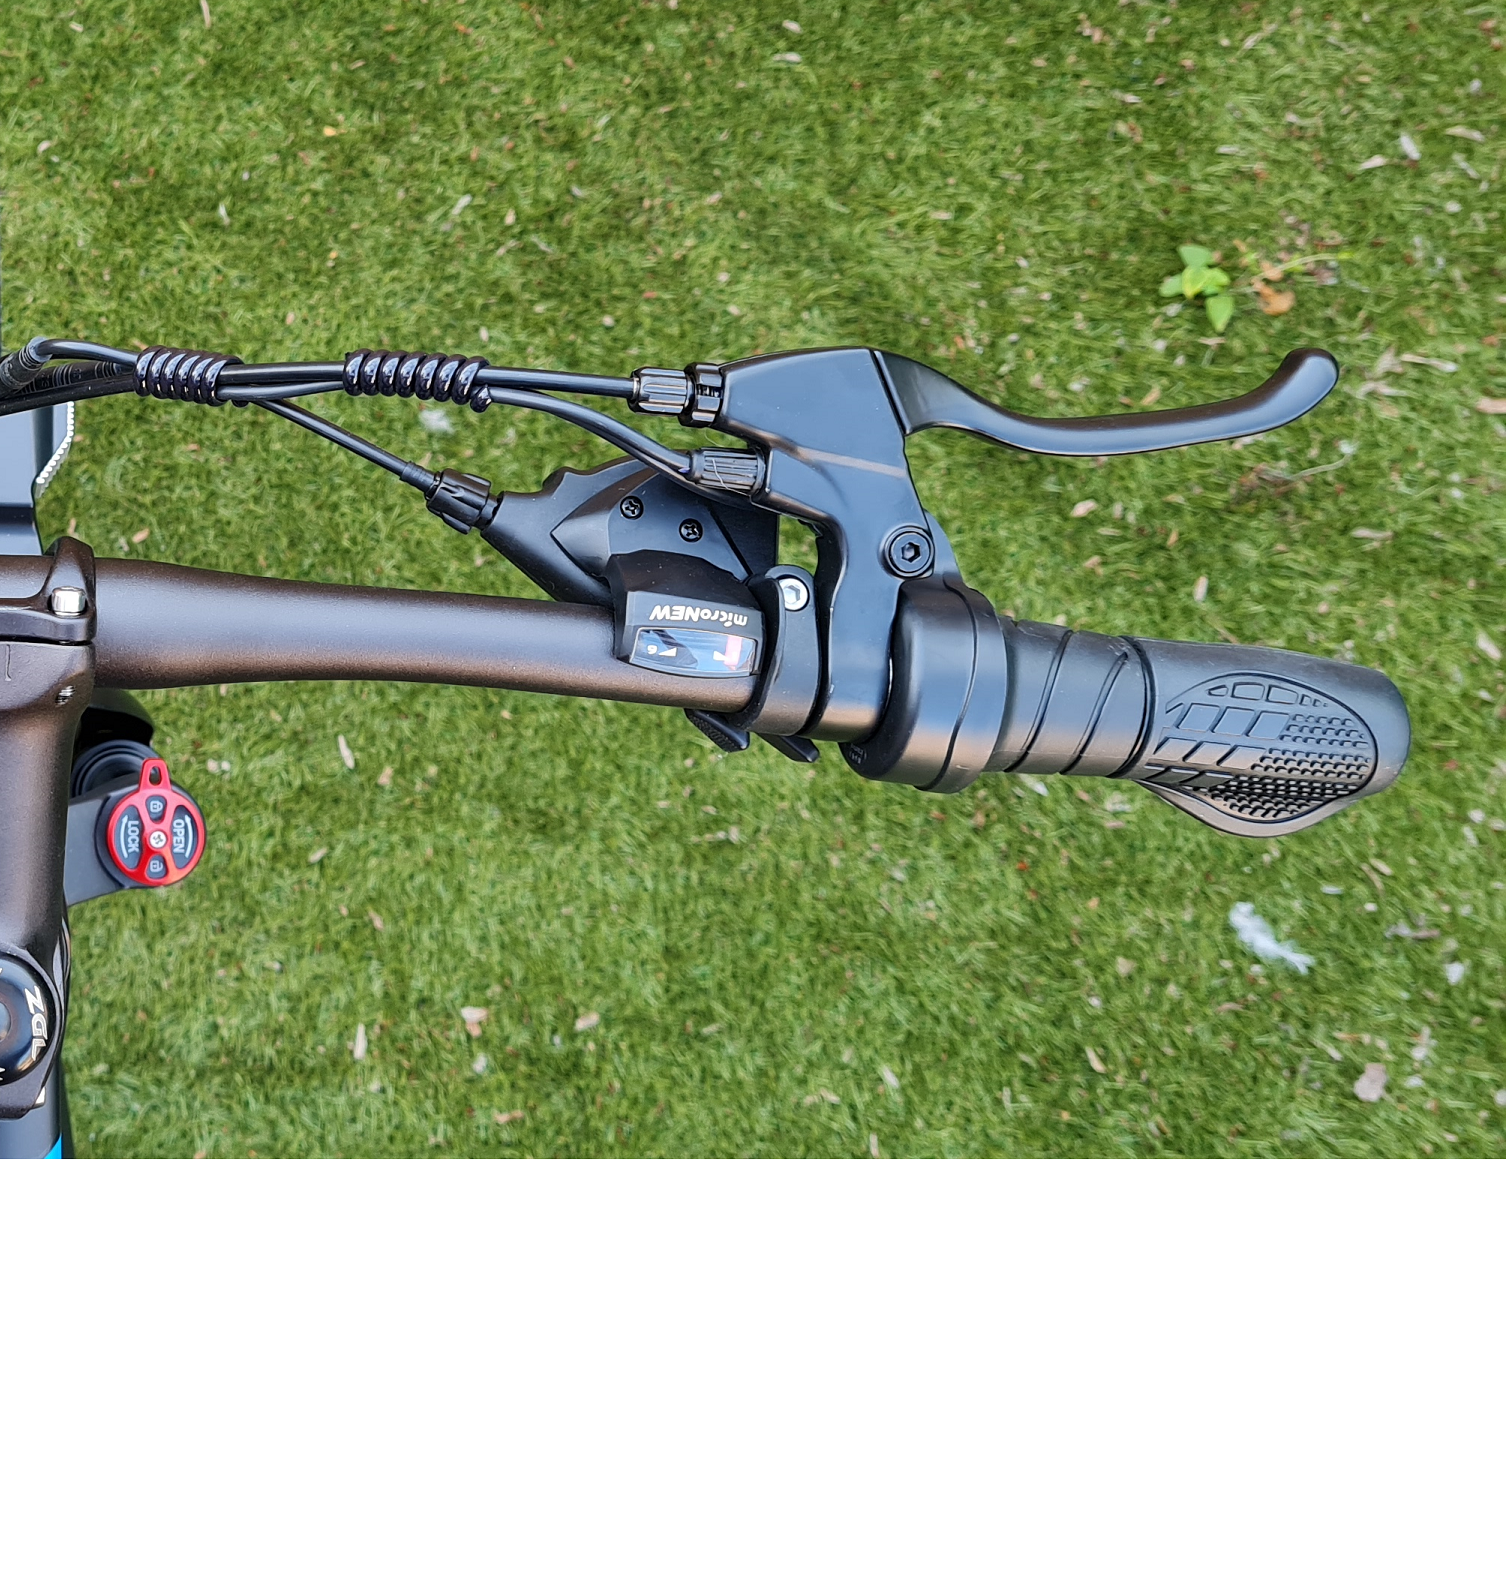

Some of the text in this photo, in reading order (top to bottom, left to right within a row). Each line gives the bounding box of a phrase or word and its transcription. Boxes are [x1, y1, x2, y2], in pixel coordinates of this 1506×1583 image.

[649, 604, 748, 628] microNEW
[127, 820, 140, 853] LOCK
[172, 818, 185, 854] OPEN
[24, 985, 48, 1061] ZGL
